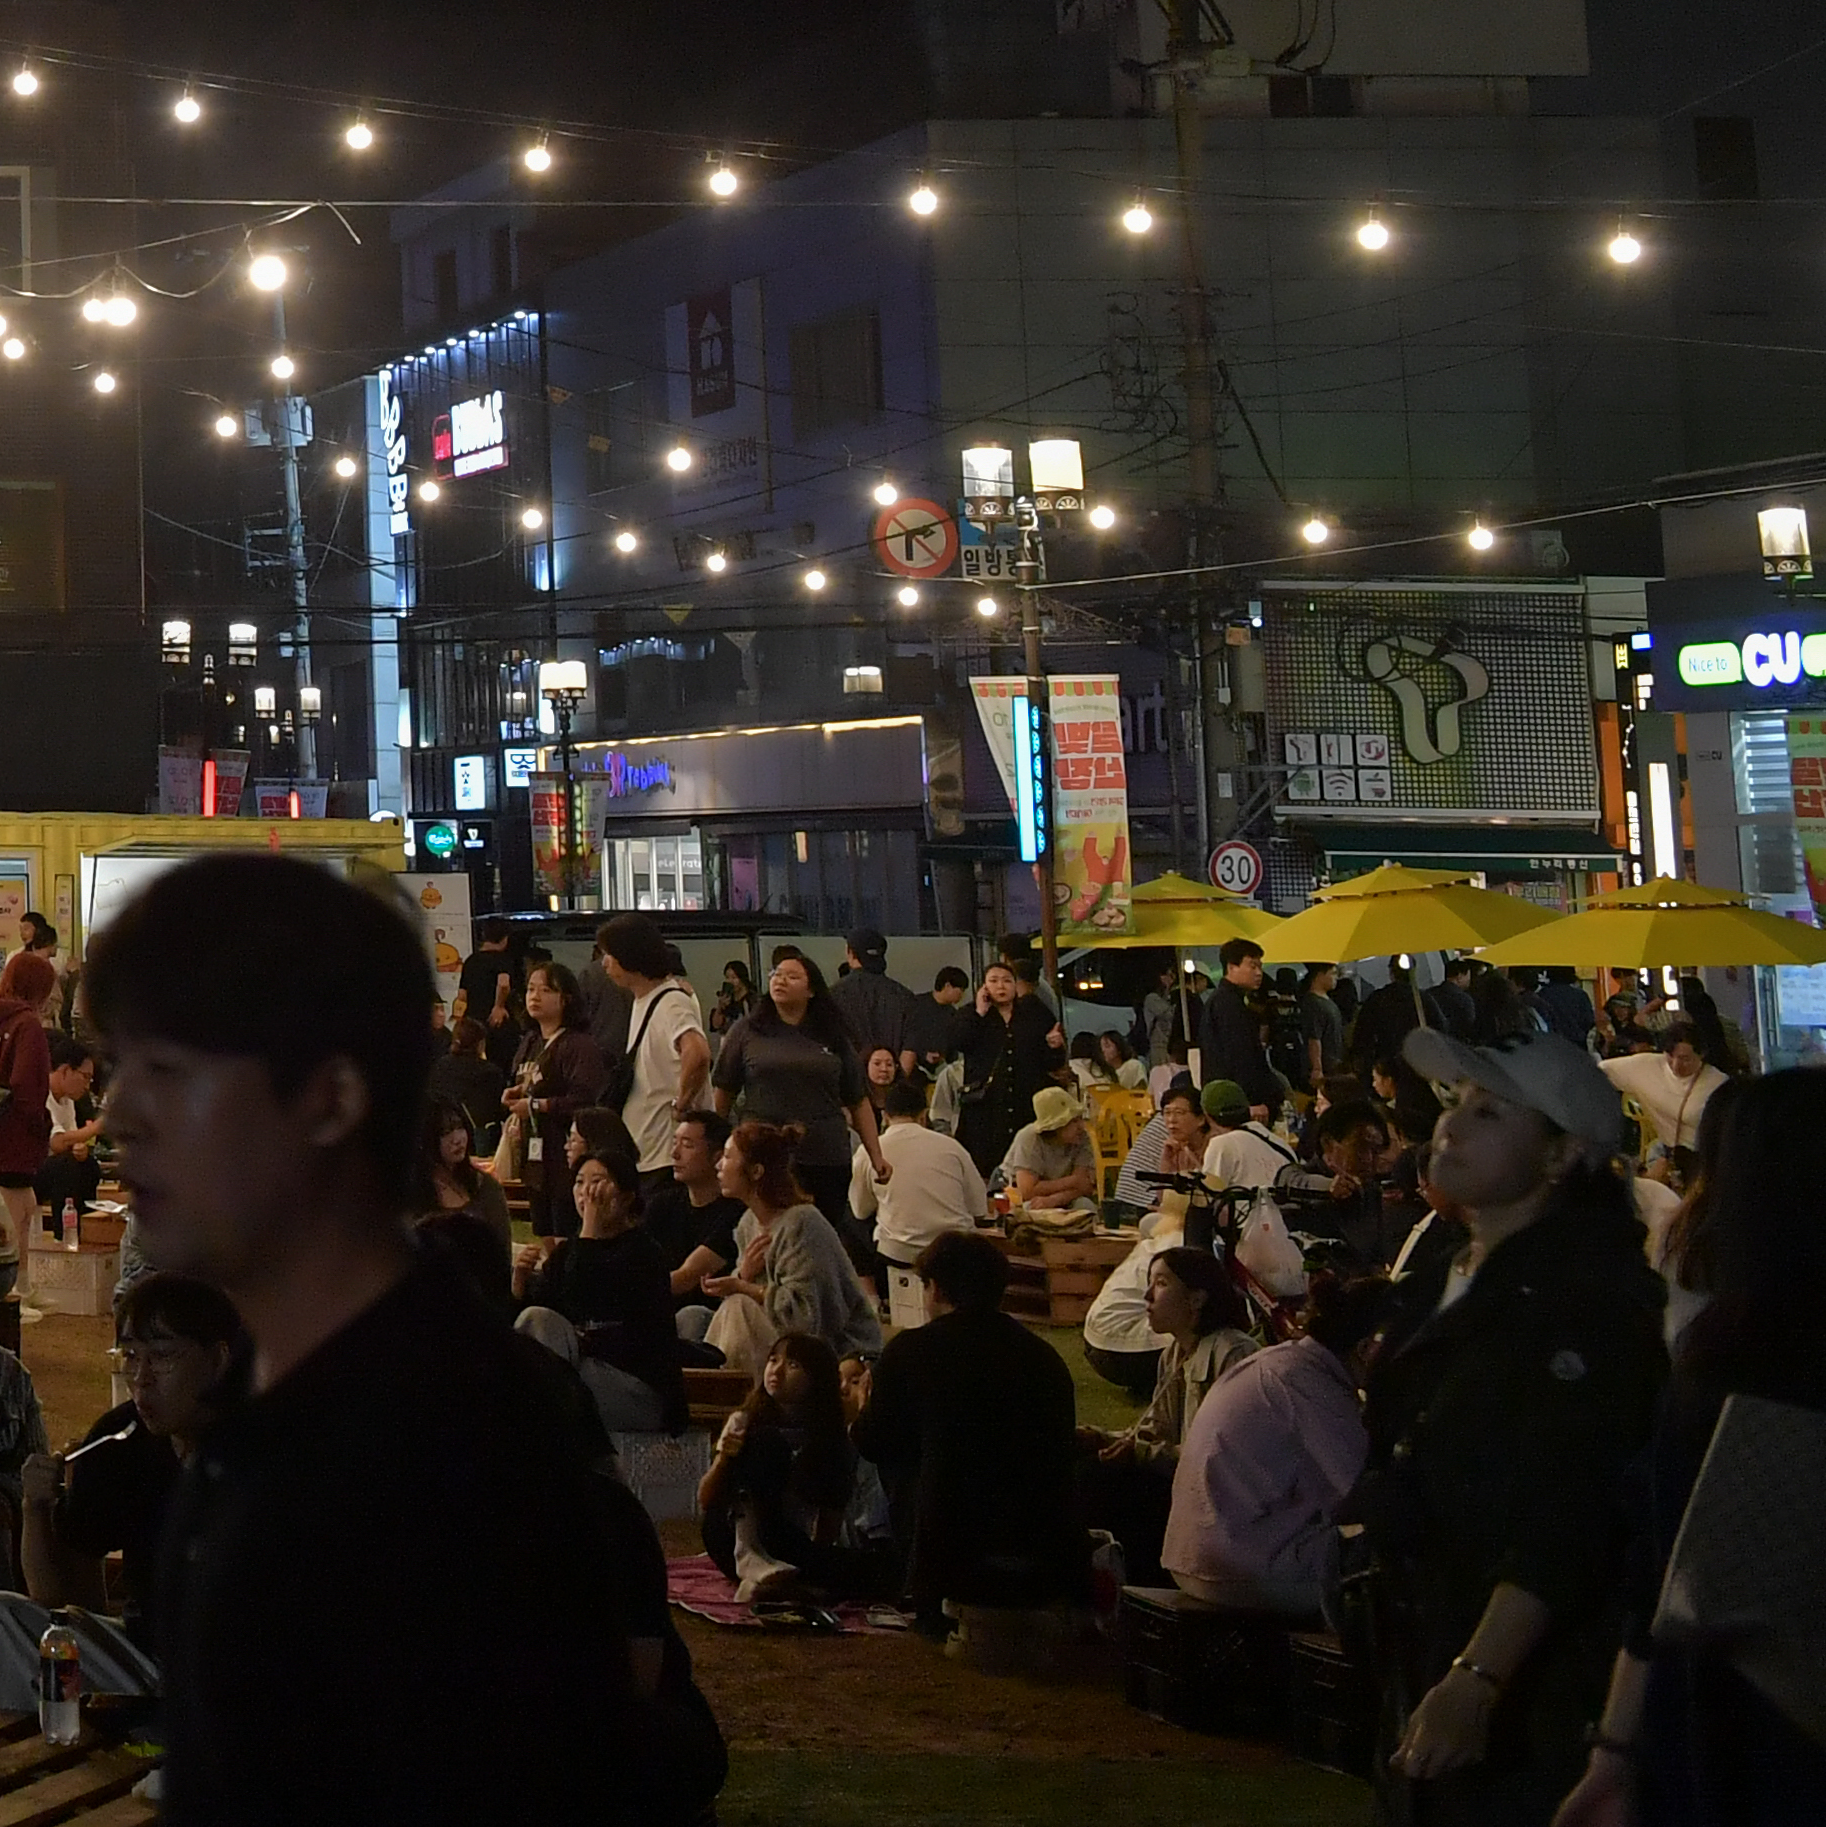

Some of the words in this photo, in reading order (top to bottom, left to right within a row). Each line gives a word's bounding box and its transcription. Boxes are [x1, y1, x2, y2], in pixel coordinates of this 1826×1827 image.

[963, 548, 1017, 577] 일방통
[1687, 656, 1713, 673] Nice
[1715, 655, 1728, 671] to
[1742, 630, 1801, 687] CU
[1220, 854, 1252, 885] 30
